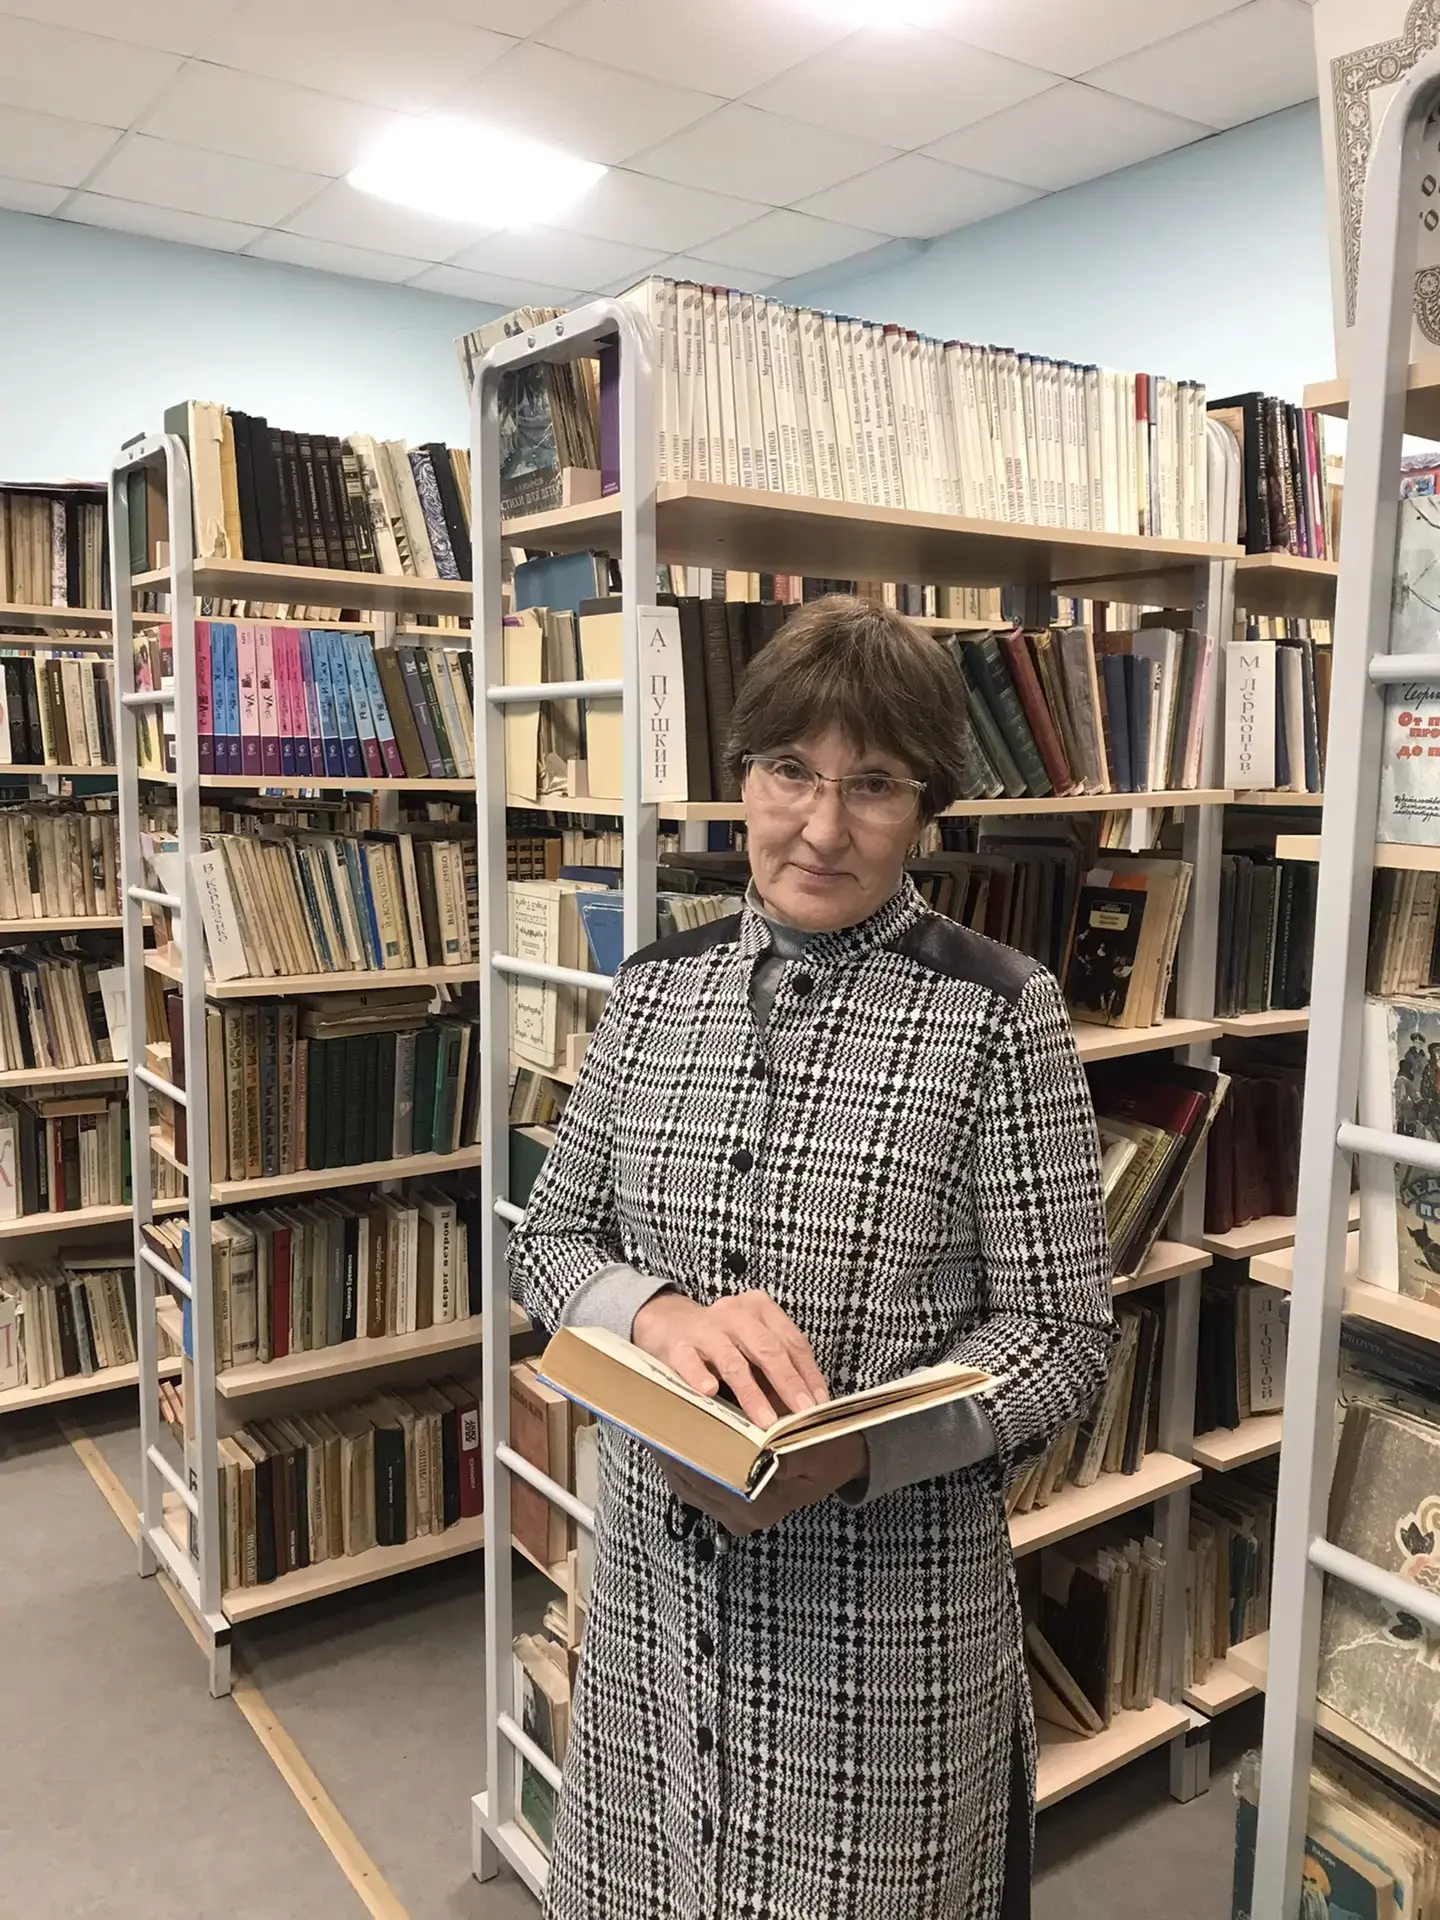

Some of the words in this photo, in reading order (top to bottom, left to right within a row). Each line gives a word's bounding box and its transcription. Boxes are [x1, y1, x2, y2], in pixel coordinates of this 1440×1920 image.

[768, 431, 777, 455] ГОГОЛЬ
[770, 459, 779, 490] НИКОЛАЙ
[525, 490, 541, 504] ДЛЯ
[442, 1222, 450, 1266] ветров
